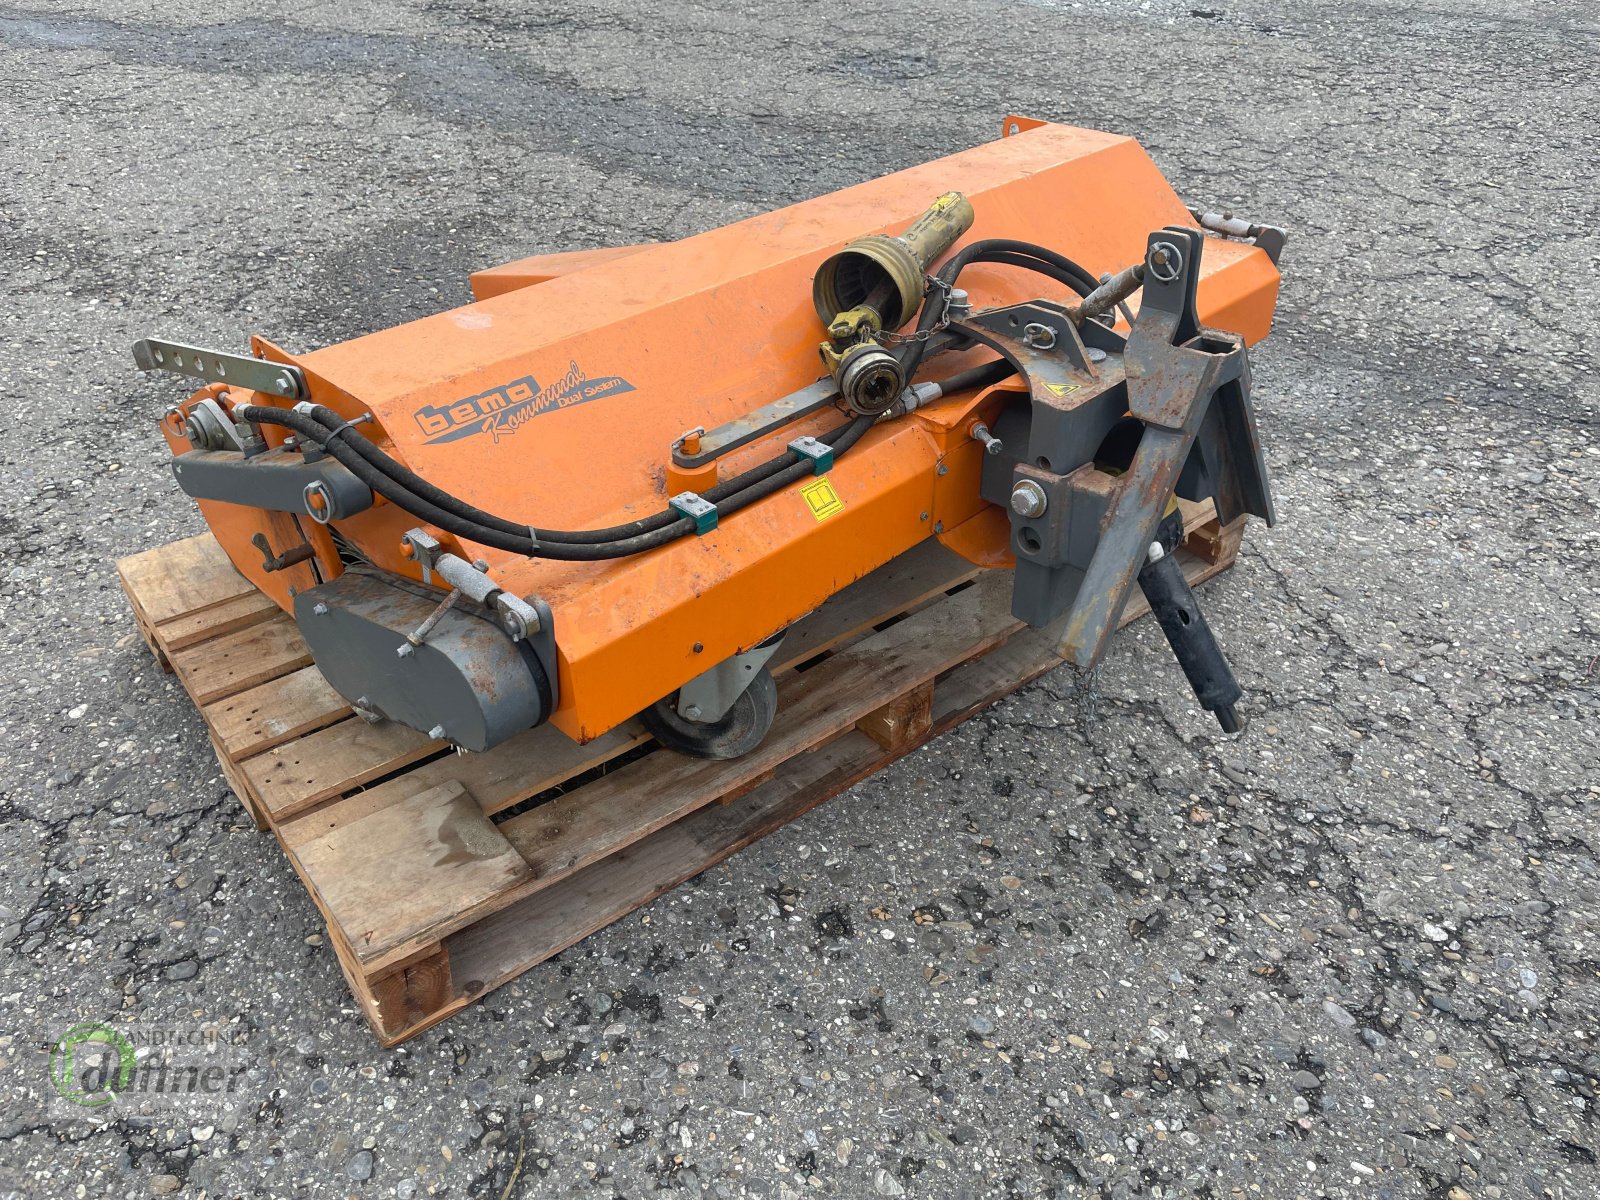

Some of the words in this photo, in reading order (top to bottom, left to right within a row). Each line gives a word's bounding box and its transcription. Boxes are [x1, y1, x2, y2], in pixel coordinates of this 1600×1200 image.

[415, 382, 534, 435] bema
[481, 360, 585, 443] Kommunal
[557, 390, 583, 408] Dual
[584, 378, 622, 396] System
